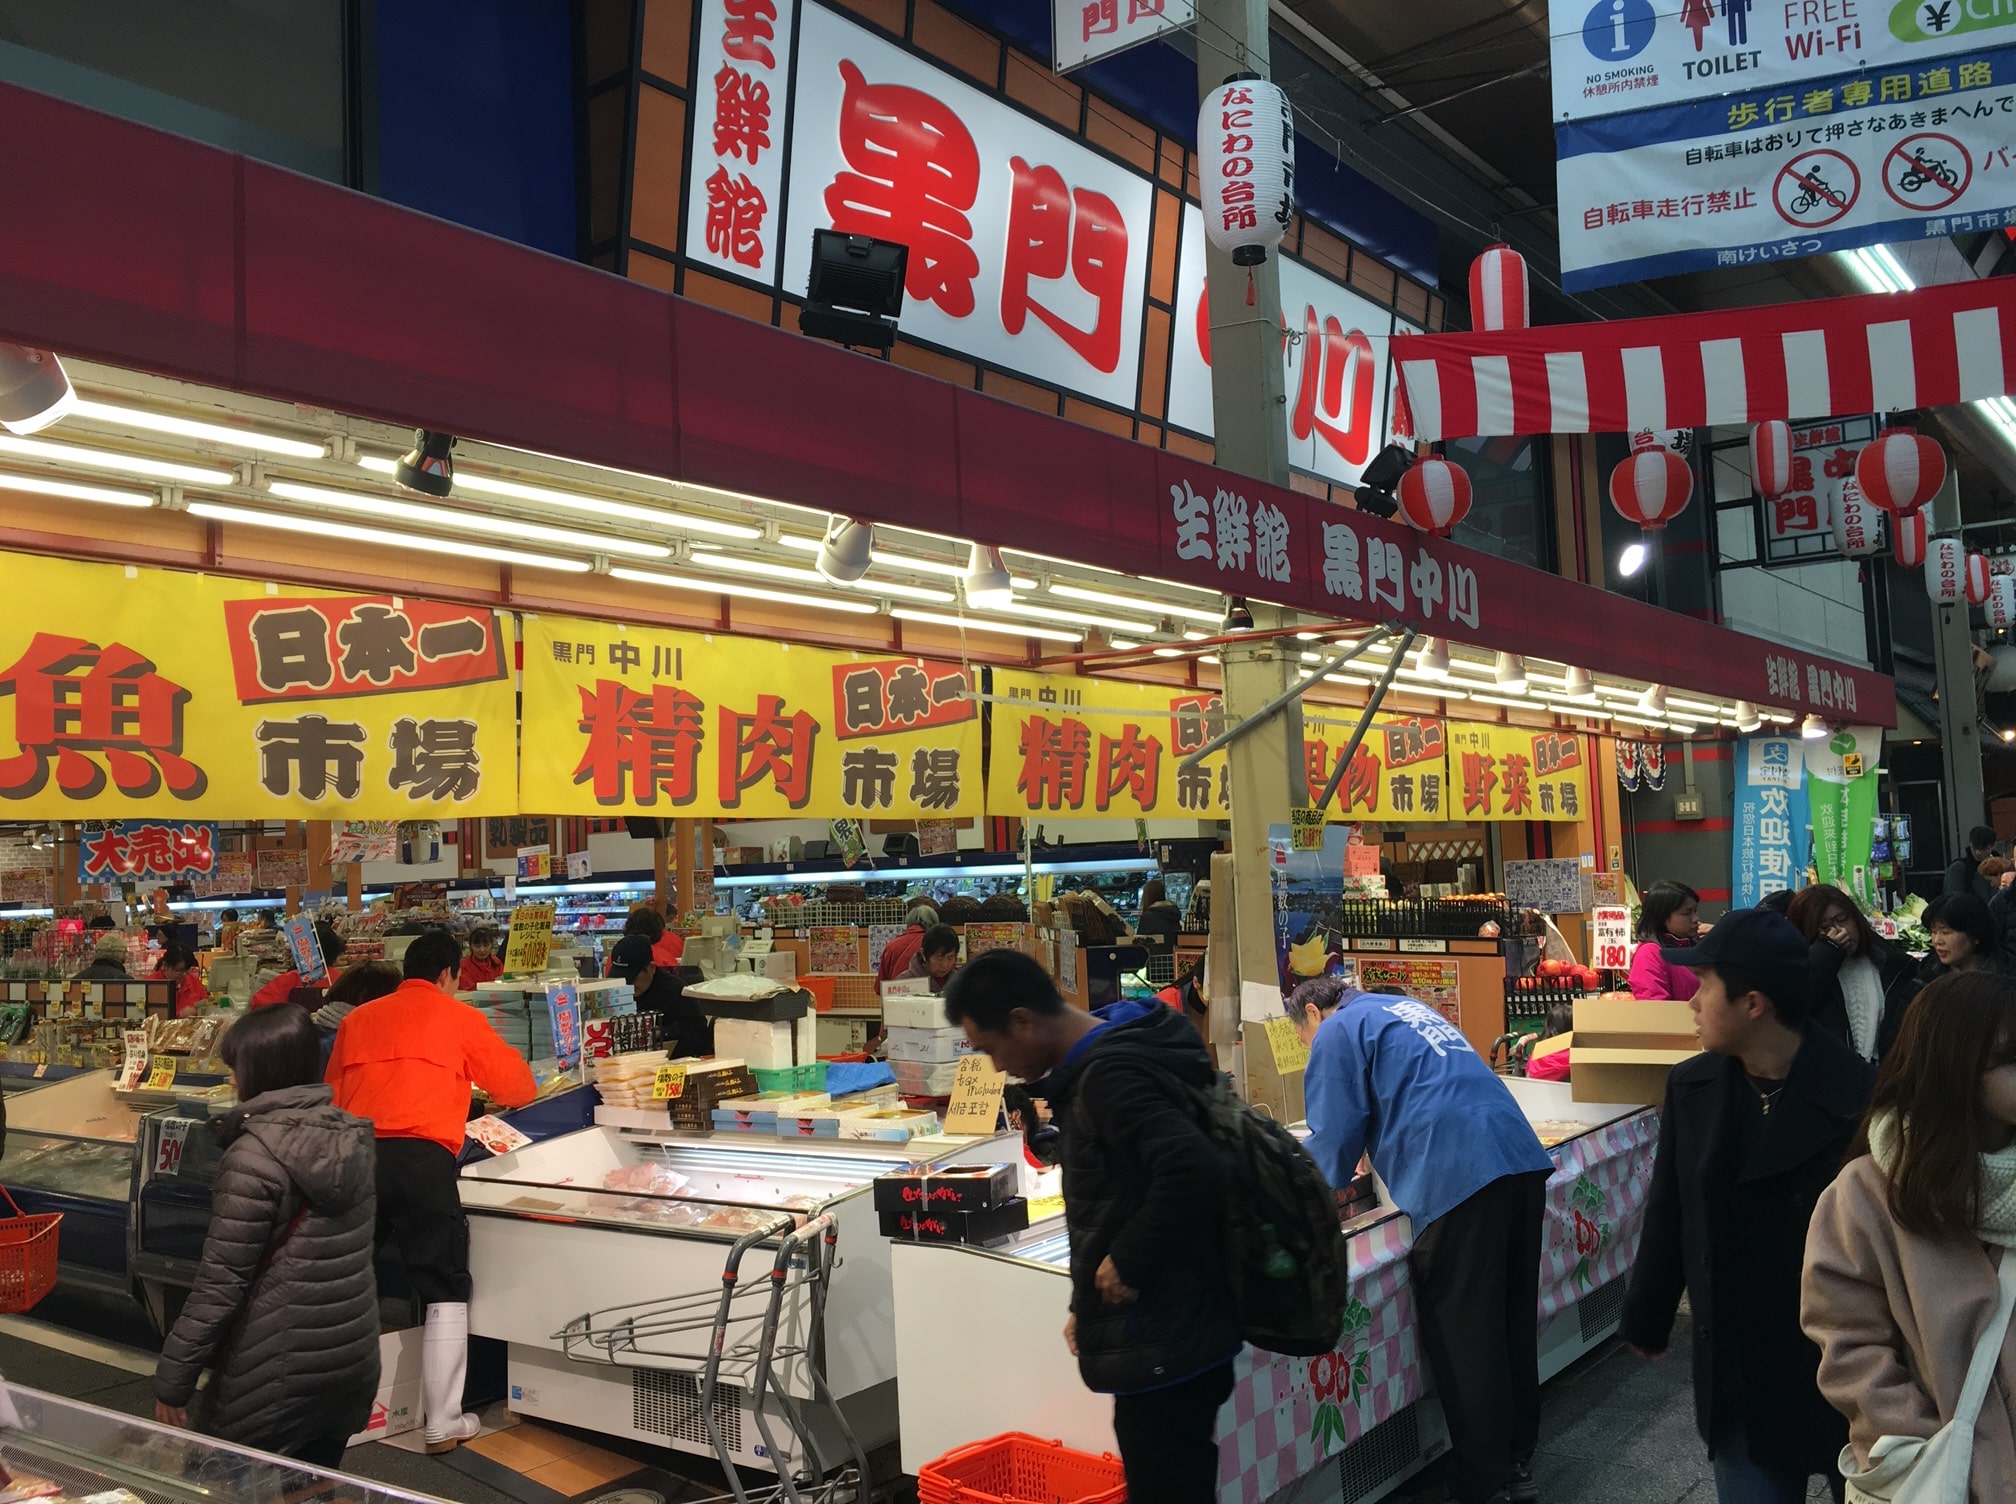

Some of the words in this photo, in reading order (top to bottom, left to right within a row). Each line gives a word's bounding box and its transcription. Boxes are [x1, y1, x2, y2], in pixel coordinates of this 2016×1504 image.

[1785, 0, 1858, 29] FREE
[1785, 23, 1863, 61] Wi-Fi
[1586, 74, 1602, 84] NO
[1604, 64, 1655, 81] SMOKING
[1682, 50, 1763, 80] TOILET
[1582, 73, 1659, 99] 休憩所内禁煙
[1728, 61, 1993, 130] 歩行者専用道路
[1221, 87, 1257, 231] なにわの台所
[1983, 145, 2016, 171] バ
[1583, 187, 1758, 231] 自転車走行禁止
[1717, 238, 1822, 267] 南けいさつ
[1321, 520, 1480, 630] 黒門中川
[1940, 543, 1956, 598] なにわの台所
[249, 603, 488, 692] 日本一
[552, 641, 596, 665] 黒門
[608, 639, 683, 681] 中川
[842, 664, 968, 731] 日本一
[1038, 686, 1081, 714] 中川
[1806, 664, 1857, 713] 黒門中川
[256, 714, 481, 801] 市場
[573, 679, 821, 810] 精肉
[1388, 719, 1442, 764] 日本一
[1469, 731, 1490, 750] 中川
[1534, 735, 1577, 773] 日本一
[841, 746, 962, 811] 市場
[1016, 715, 1163, 812] 精肉
[1461, 751, 1533, 816] 野菜
[1389, 773, 1442, 814] 市場
[1538, 781, 1579, 816] 市場
[1600, 944, 1627, 967] 180
[1382, 1001, 1476, 1057] 黒門
[957, 1074, 978, 1087] tax
[967, 1082, 1002, 1097] included
[948, 1101, 989, 1116] 세금포함
